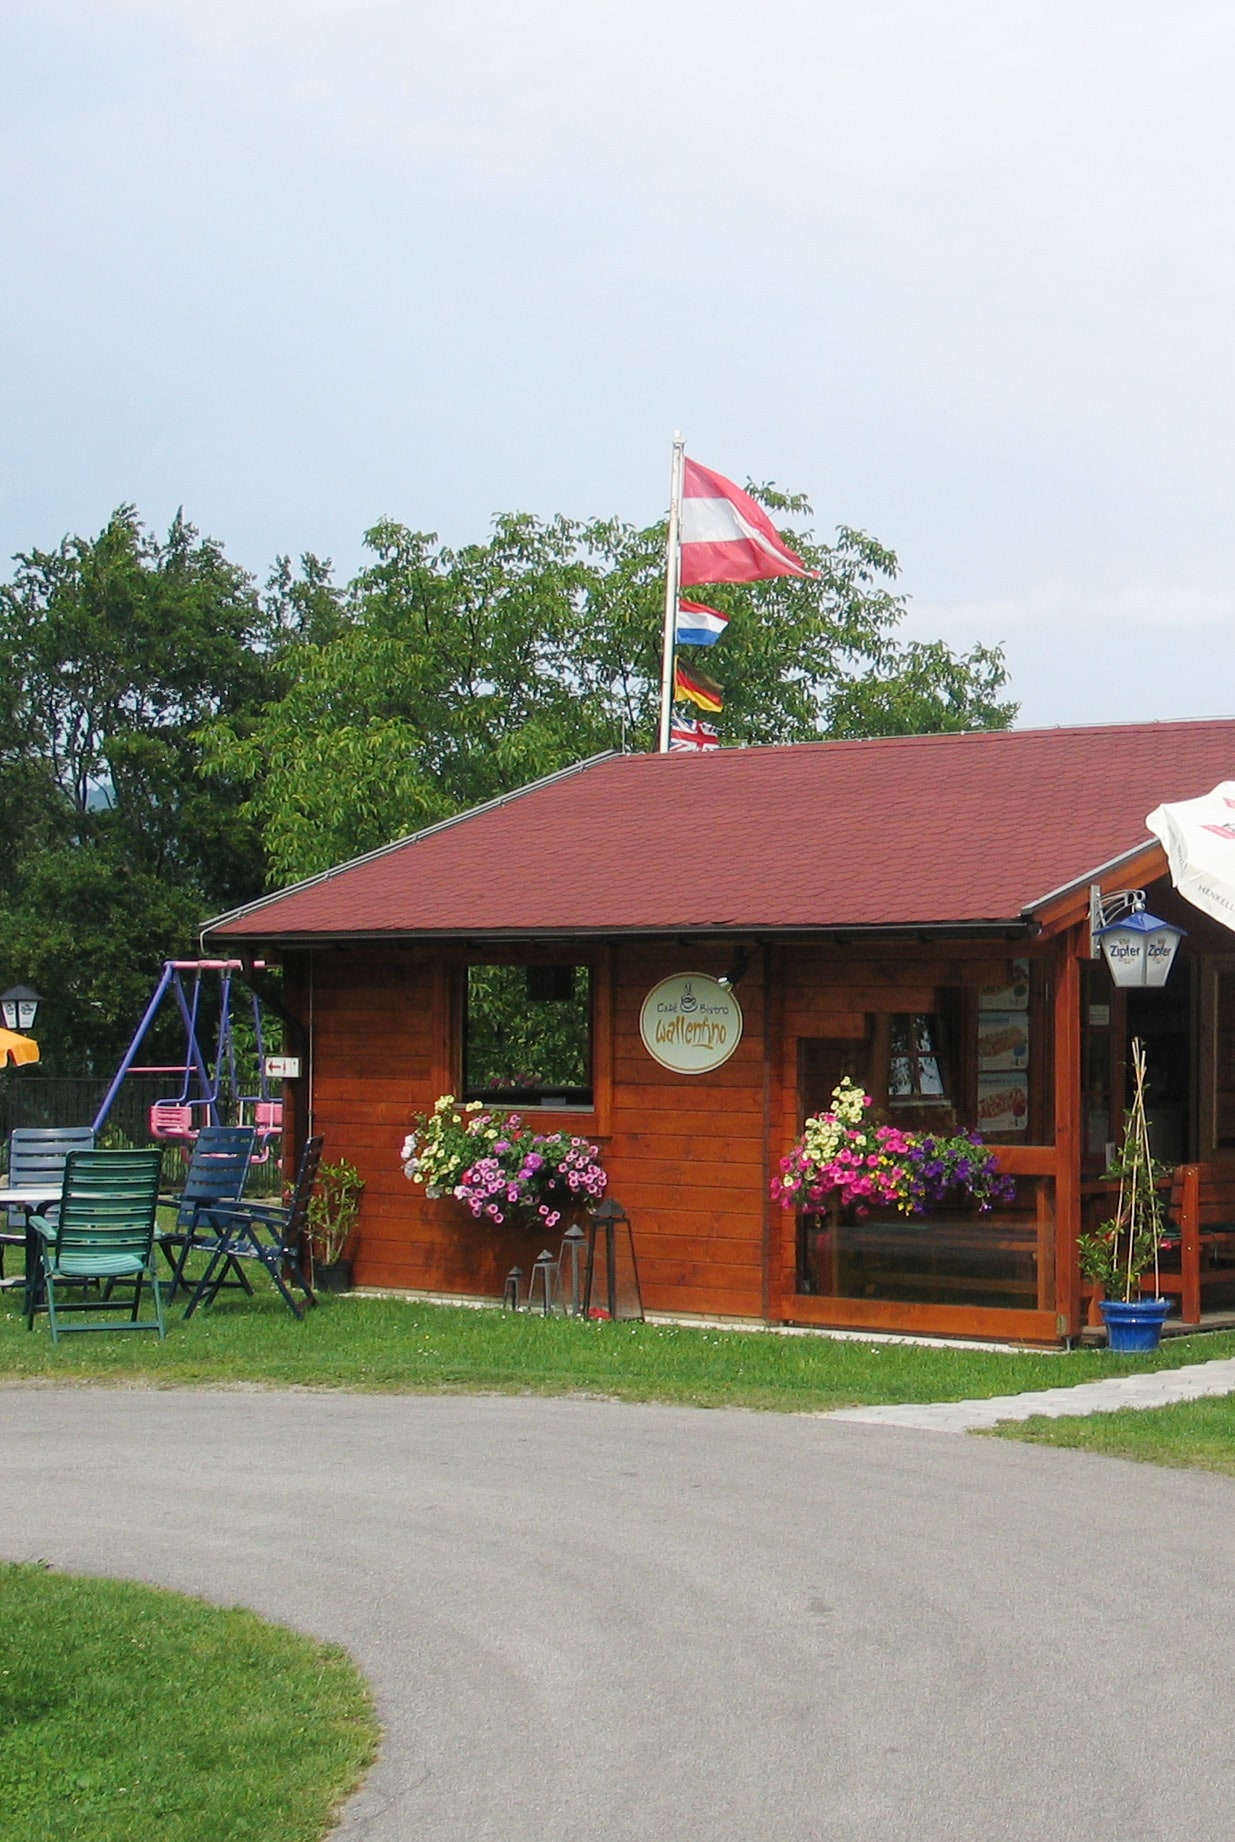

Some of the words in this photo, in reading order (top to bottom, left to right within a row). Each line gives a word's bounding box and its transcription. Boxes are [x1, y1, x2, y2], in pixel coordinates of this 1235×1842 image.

[1197, 884, 1235, 911] HENKELL
[1109, 944, 1141, 959] Zipfer
[699, 1002, 730, 1015] Bistro
